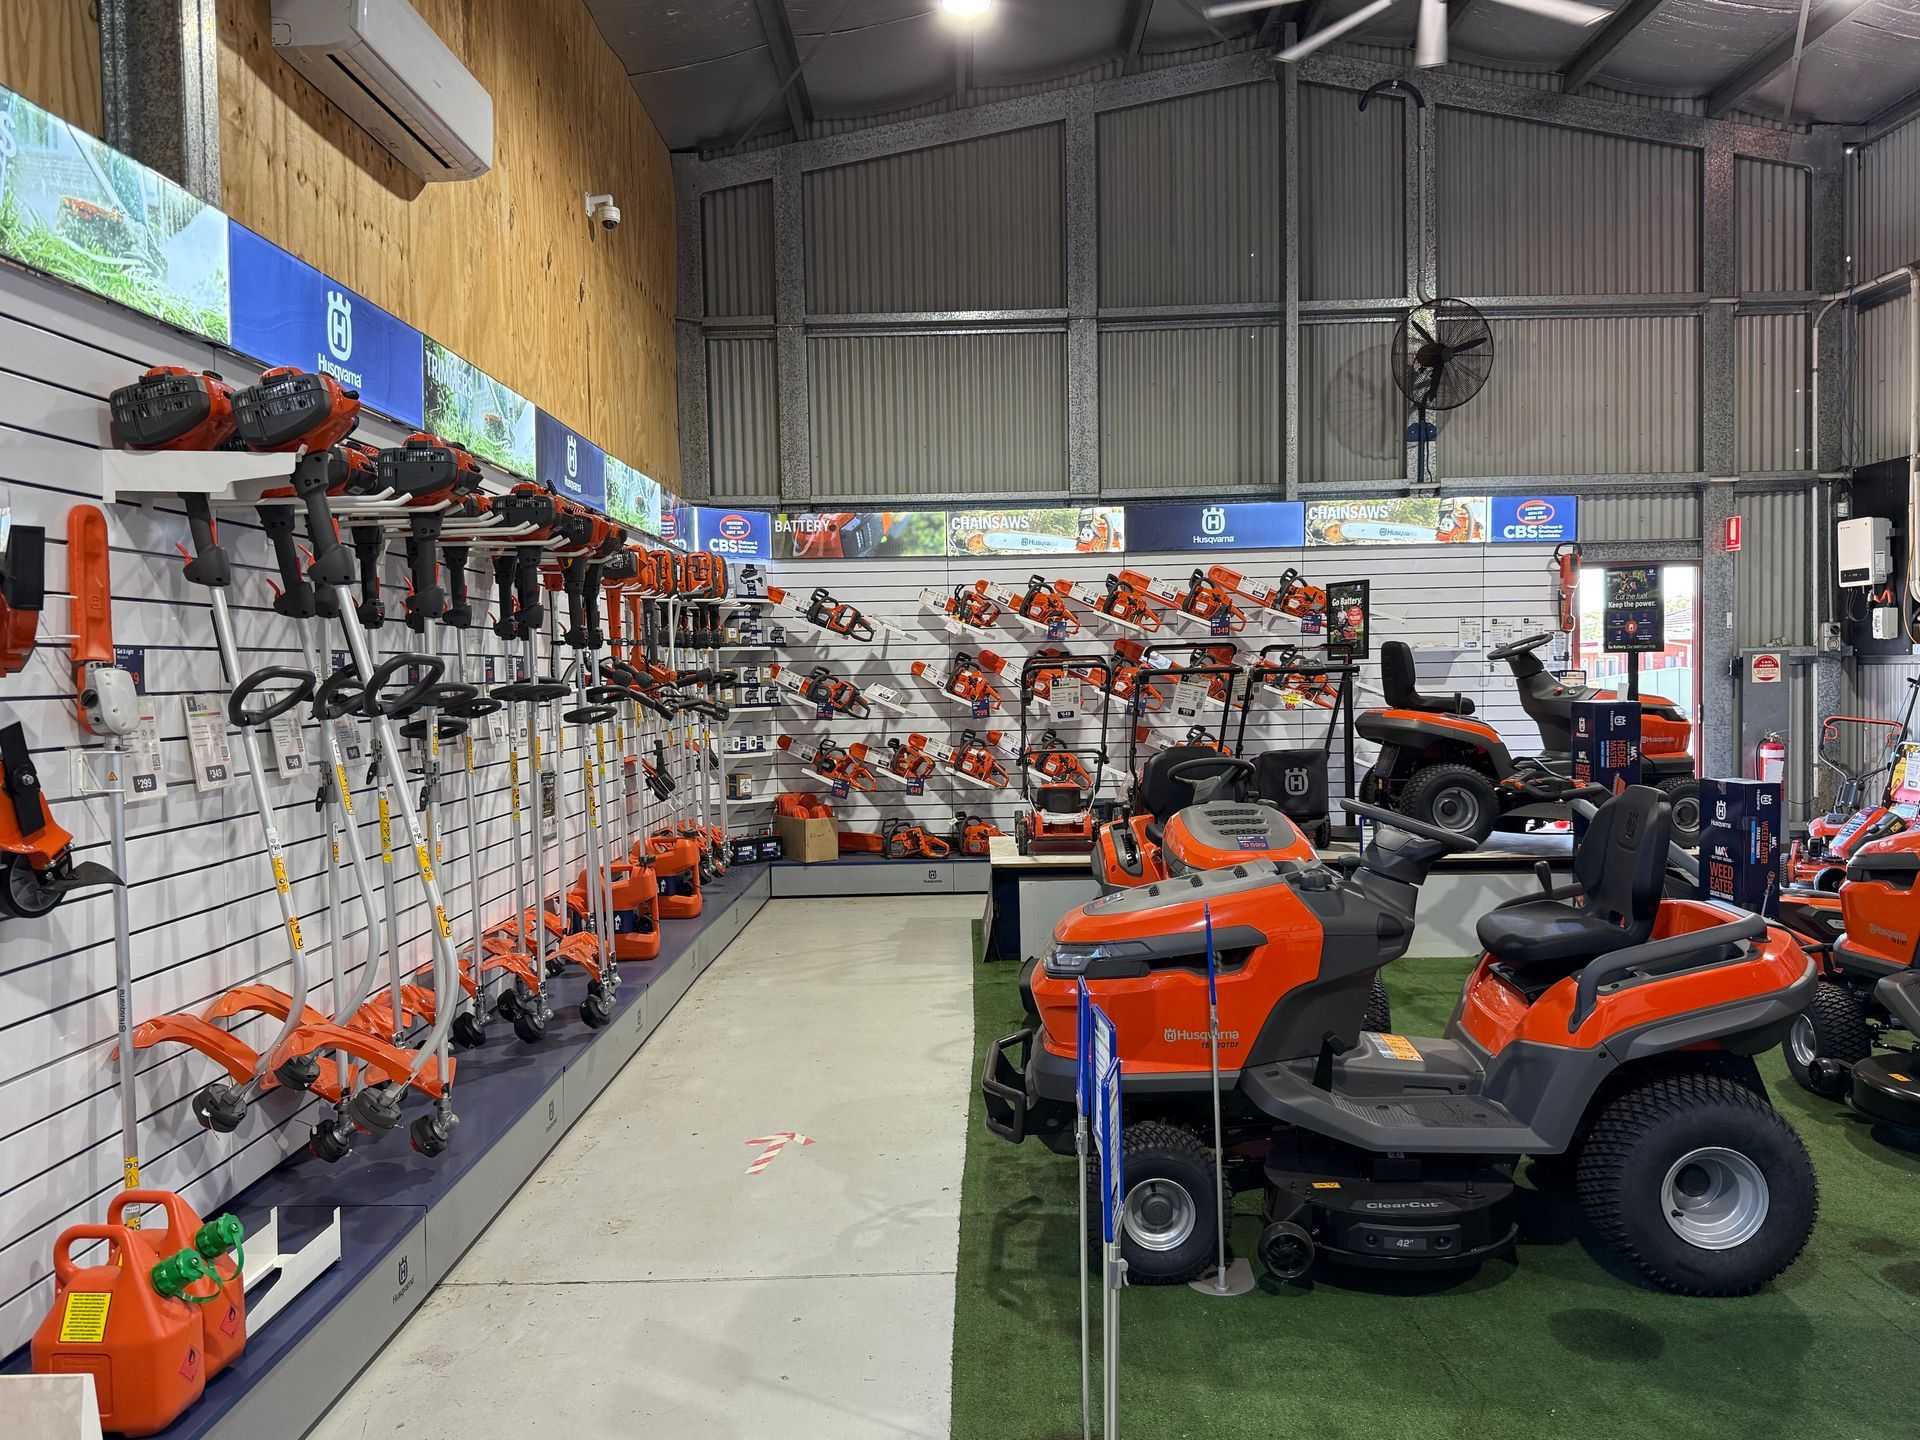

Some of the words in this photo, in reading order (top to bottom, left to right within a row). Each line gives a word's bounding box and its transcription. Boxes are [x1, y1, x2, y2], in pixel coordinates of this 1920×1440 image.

[318, 353, 362, 389] Husqvarna
[1308, 505, 1389, 520] CHAINSAWS
[774, 520, 830, 533] BATTERY
[951, 515, 1030, 530] CHAINSAWS
[1503, 525, 1538, 539] CBS
[709, 538, 738, 553] CBS
[1193, 535, 1235, 544] Husqvarna
[1331, 598, 1340, 606] Go
[1340, 597, 1362, 606] Battery.
[1608, 601, 1624, 609] Keep
[1624, 600, 1635, 608] the
[1609, 740, 1617, 768] MASTER
[1617, 740, 1626, 767] HEDGE
[209, 768, 222, 778] $349
[136, 778, 152, 789] $299
[1710, 819, 1732, 829] Husqvarna
[1761, 820, 1769, 841] WEED
[1709, 861, 1734, 880] WEED
[1709, 876, 1734, 894] EATER
[1396, 1239, 1414, 1248] 42"
